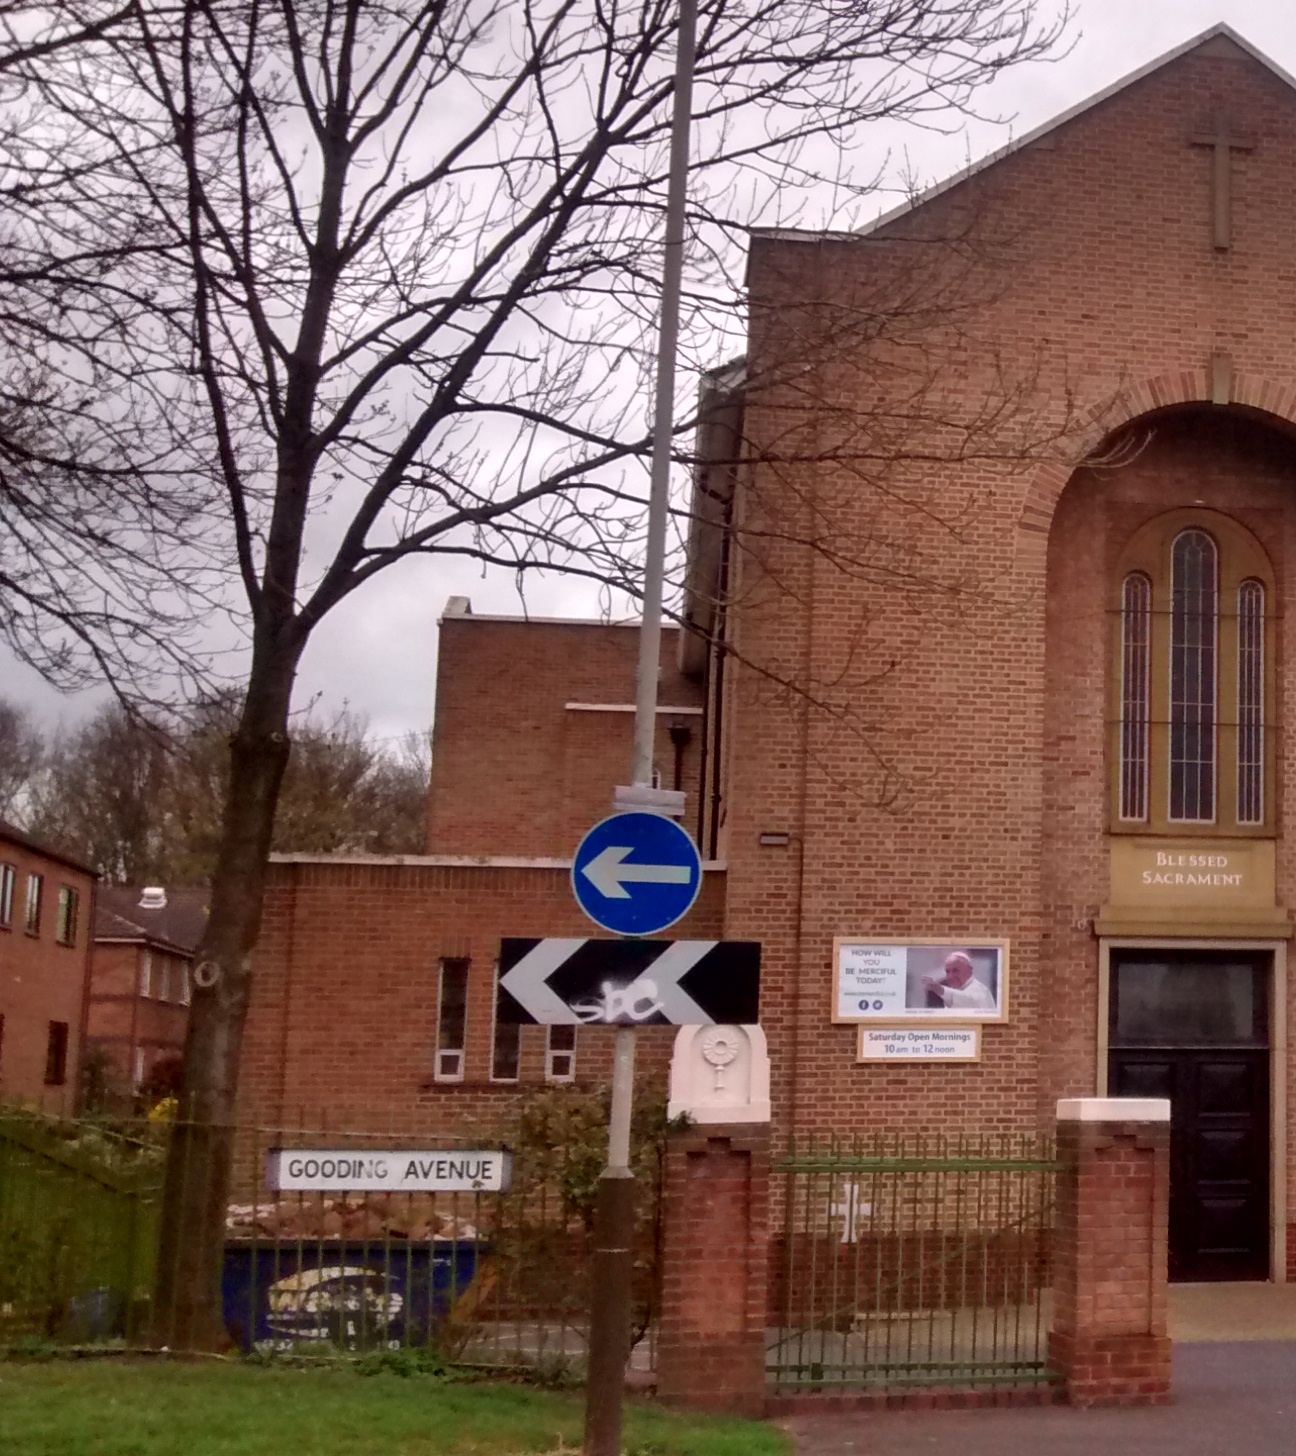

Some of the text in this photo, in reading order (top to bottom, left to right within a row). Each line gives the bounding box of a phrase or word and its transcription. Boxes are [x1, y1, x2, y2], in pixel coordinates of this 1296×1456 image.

[1156, 852, 1228, 867] BLESSED
[1142, 871, 1243, 886] SACRAMENT
[851, 949, 892, 957] HOW WILL
[845, 967, 855, 975] BE
[869, 1033, 971, 1042] Saturday Open Mornings
[885, 1044, 895, 1053] 10
[923, 1044, 933, 1053] 12
[289, 1159, 493, 1180] GOODING AVENUE
